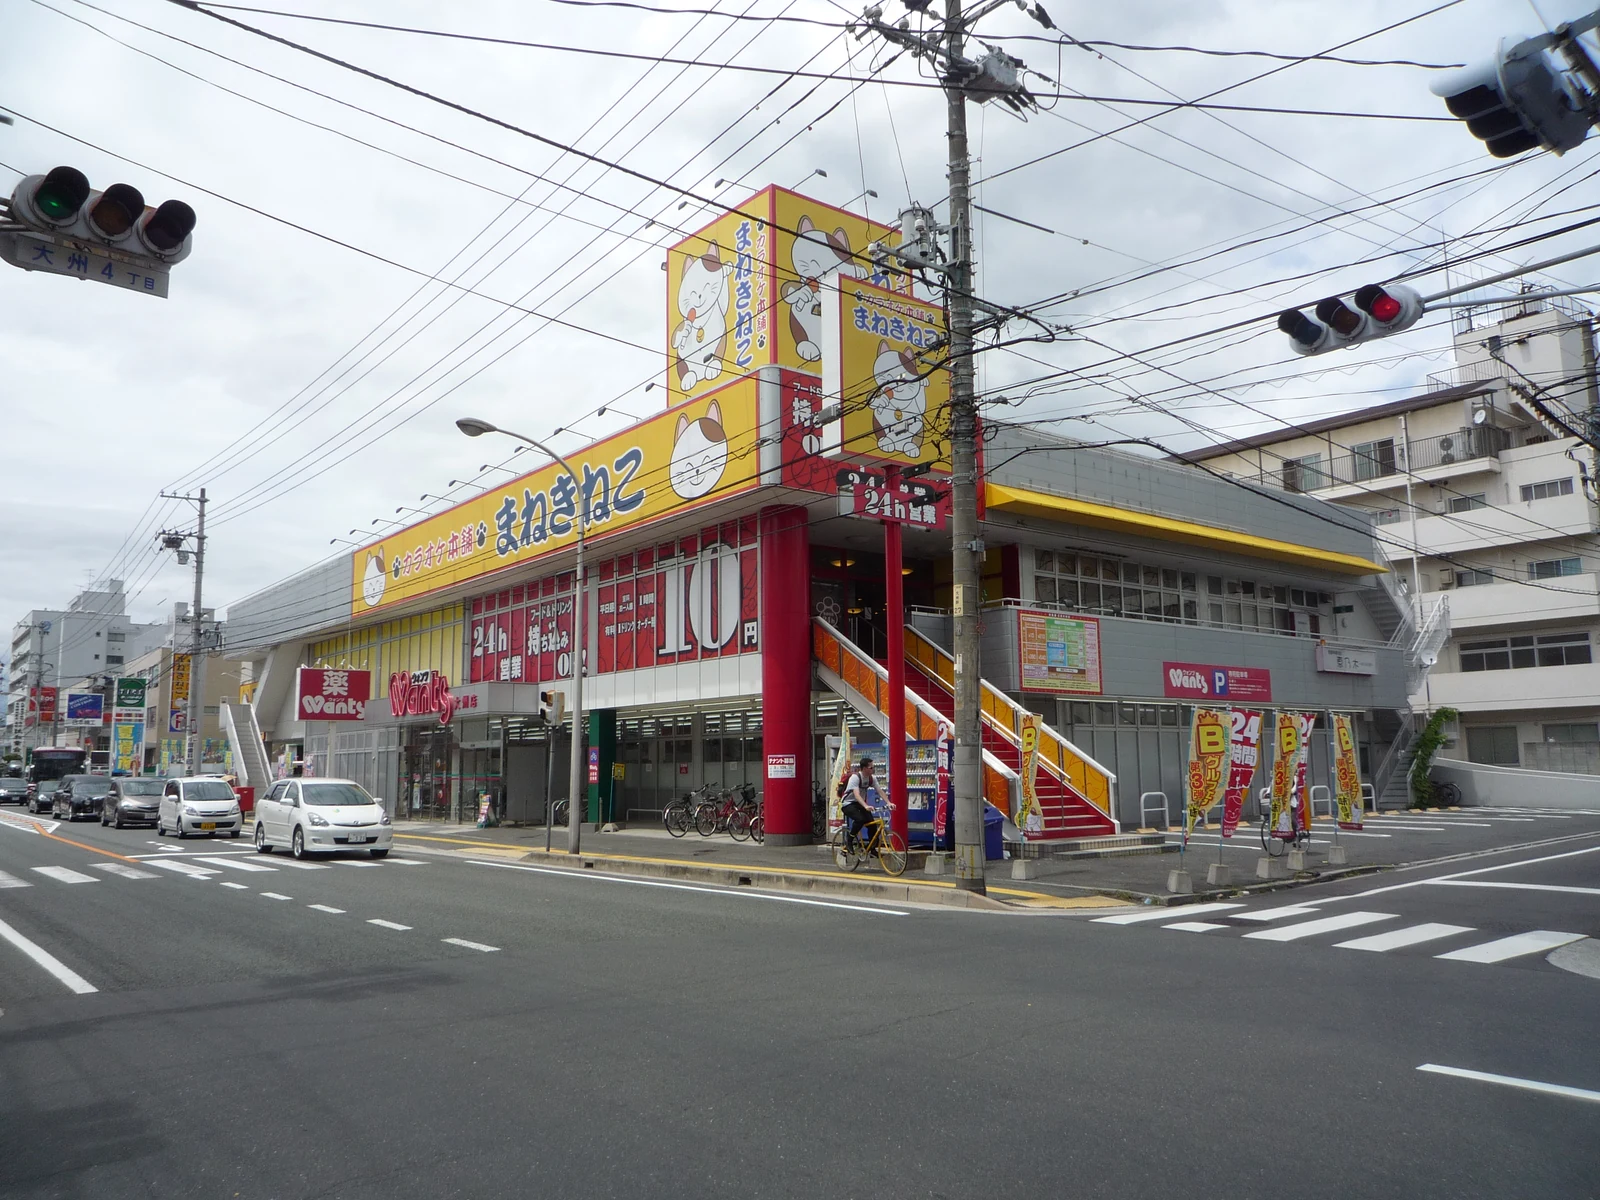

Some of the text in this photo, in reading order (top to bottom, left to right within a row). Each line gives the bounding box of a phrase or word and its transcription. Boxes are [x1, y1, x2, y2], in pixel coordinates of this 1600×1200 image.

[32, 245, 155, 290] 大州4丁目
[756, 233, 767, 333] カラオケ本舗
[734, 220, 753, 368] まねきねこ
[865, 294, 925, 321] カラオケ本舗
[853, 307, 939, 348] まねきねこ
[402, 446, 645, 577] カラオケ本舗 まねきねこ
[473, 623, 507, 657] 24h
[528, 621, 569, 656] 持ち込み
[322, 671, 349, 696] 薬
[500, 655, 522, 681] 営業
[1169, 668, 1208, 694] Wants
[1215, 672, 1225, 693] P
[302, 695, 365, 719] Wants
[389, 670, 454, 724] Wants
[1231, 711, 1261, 744] 24
